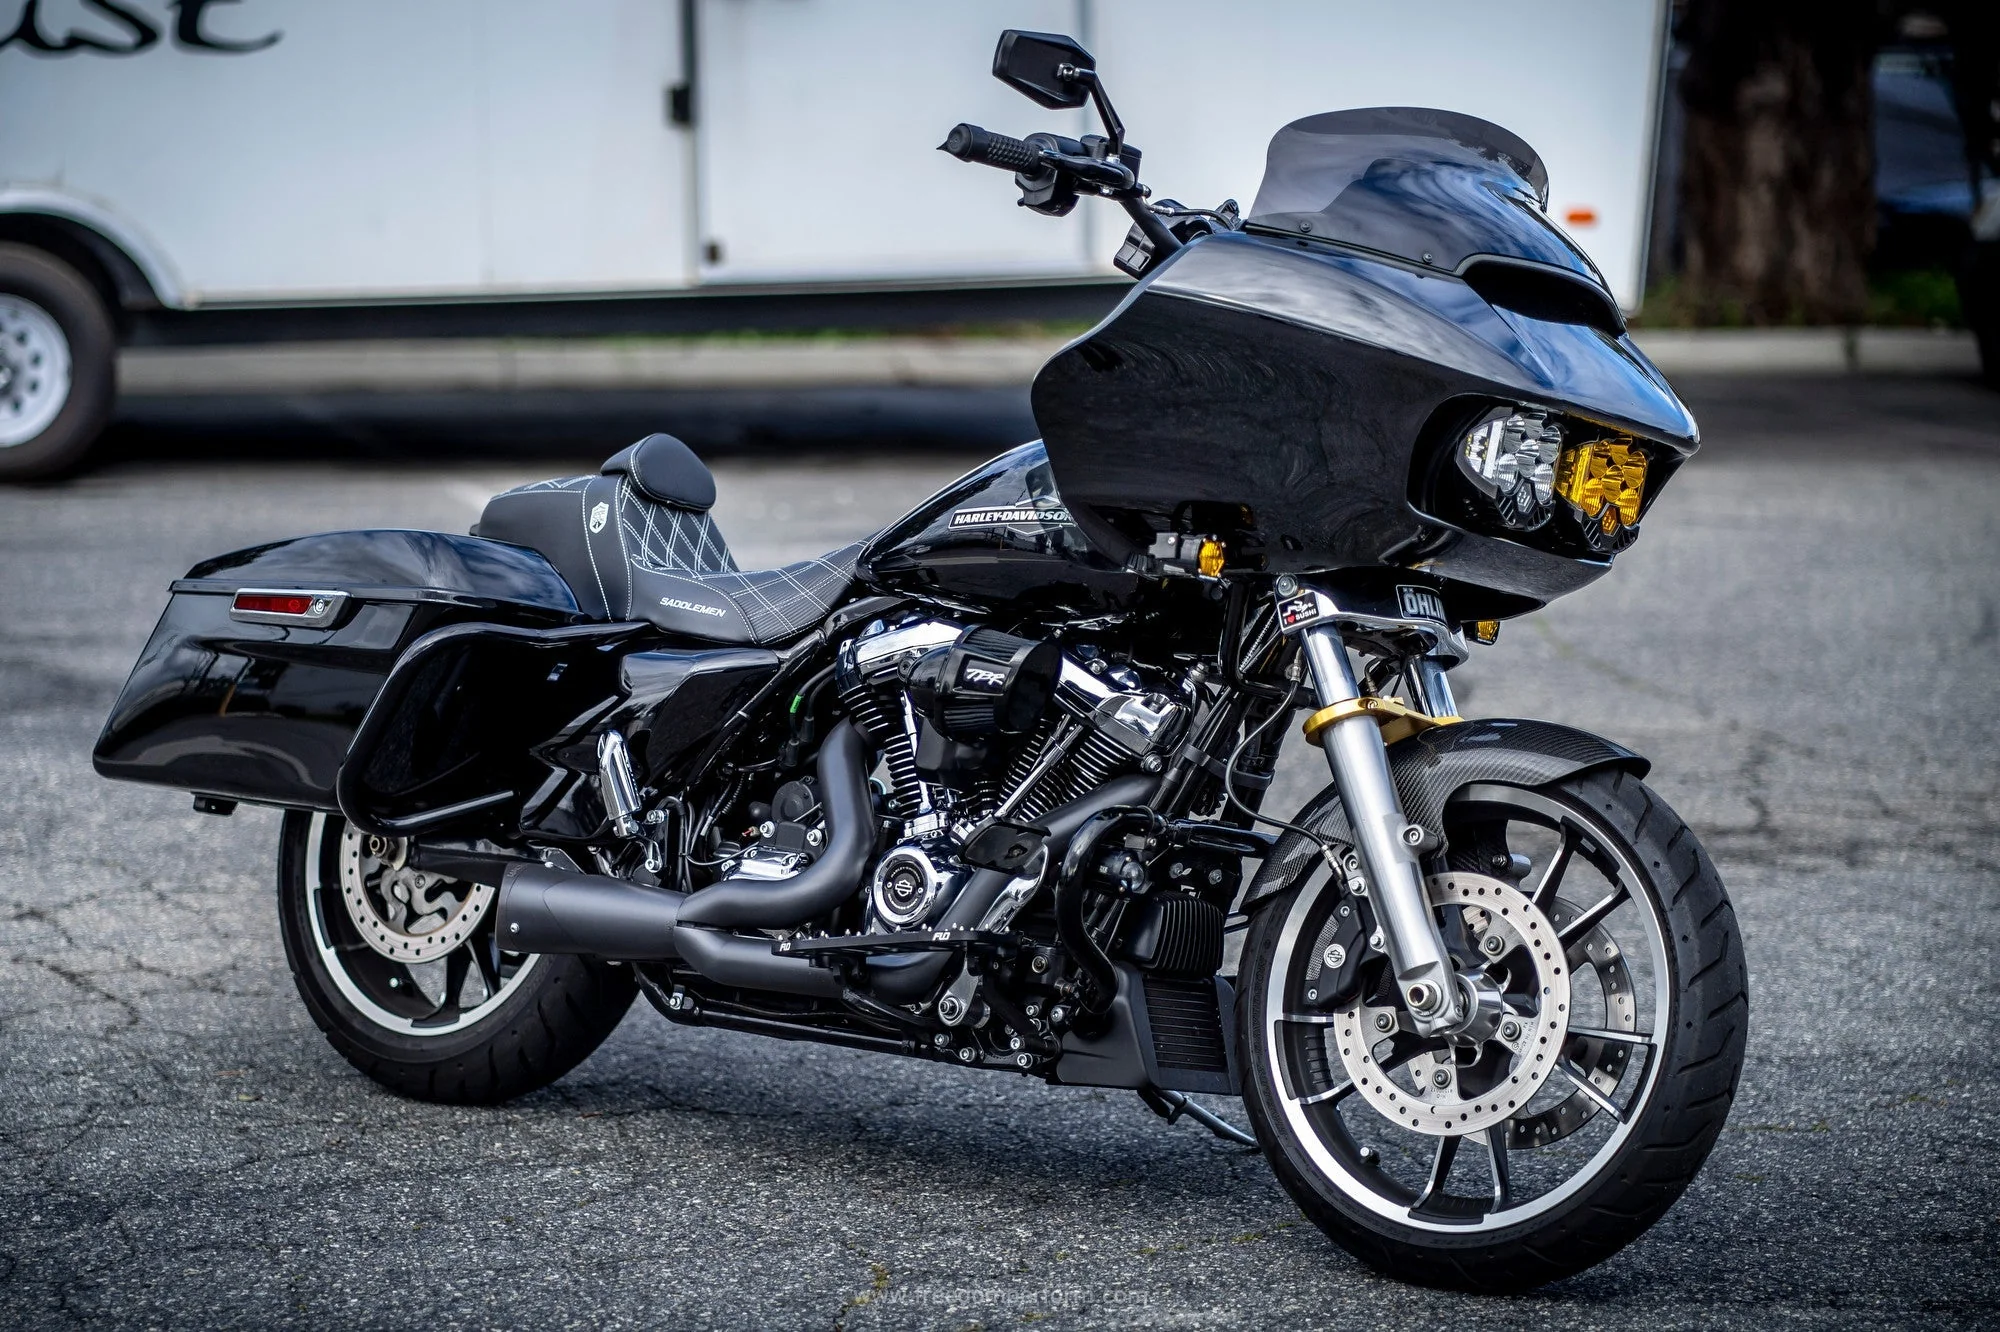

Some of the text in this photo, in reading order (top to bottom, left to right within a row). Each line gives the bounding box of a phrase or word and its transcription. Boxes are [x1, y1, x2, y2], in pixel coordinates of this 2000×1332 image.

[659, 597, 727, 617] SADDLEMEN
[1295, 608, 1317, 621] SUSHI
[932, 931, 951, 941] FLO
